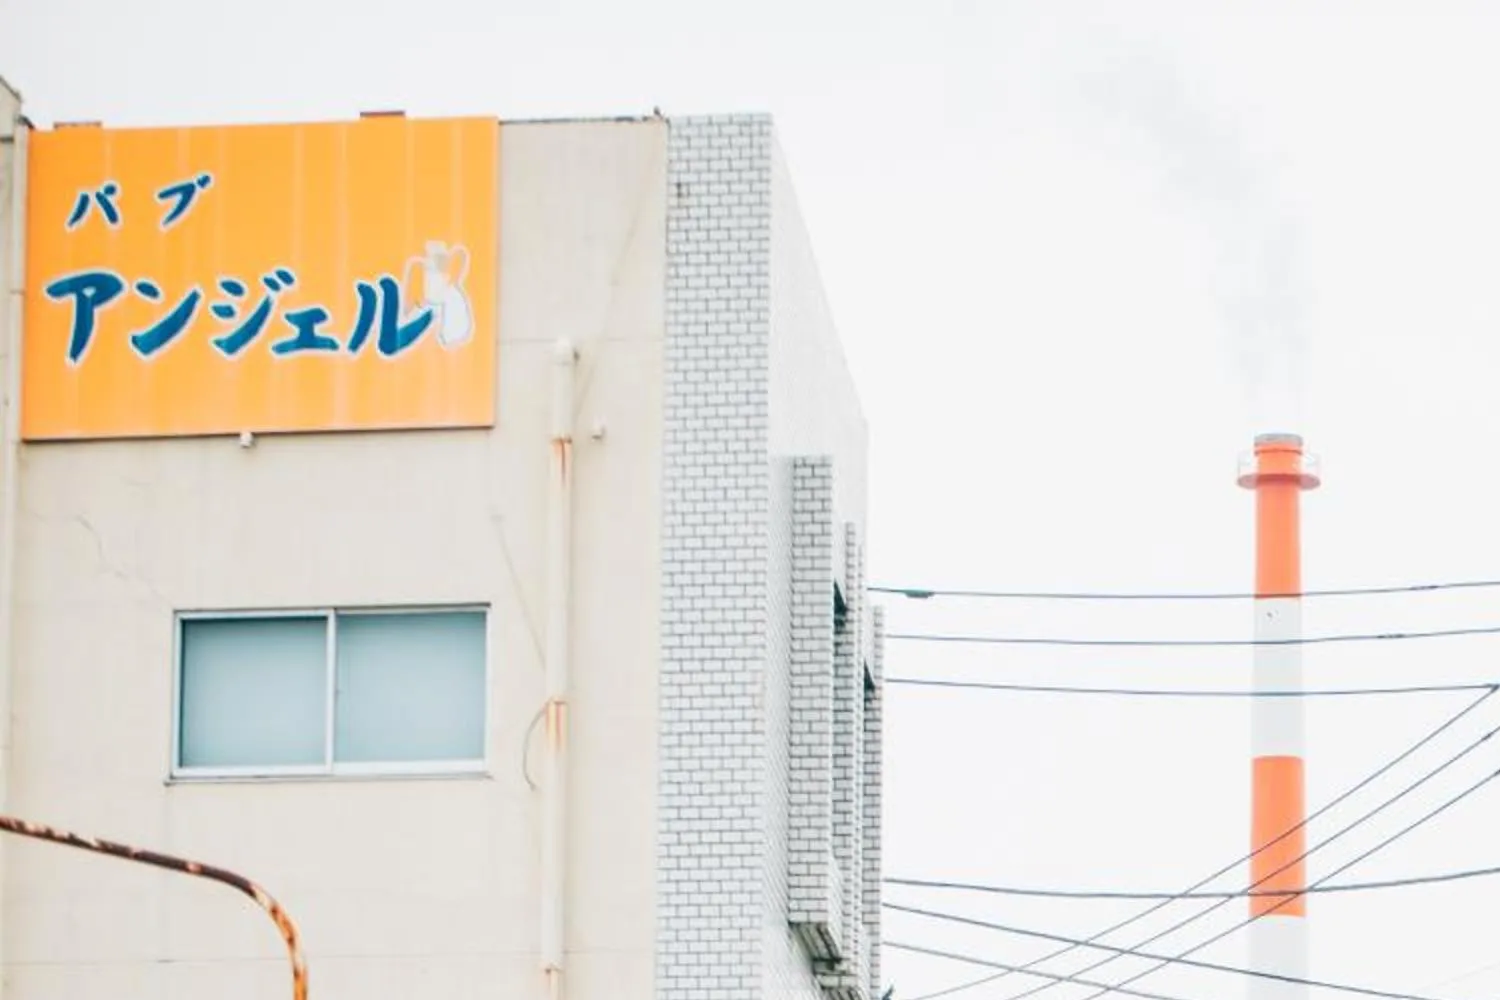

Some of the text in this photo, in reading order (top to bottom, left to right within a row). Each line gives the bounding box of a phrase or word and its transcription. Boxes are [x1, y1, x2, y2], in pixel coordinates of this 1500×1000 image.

[45, 268, 434, 363] アンジェル
